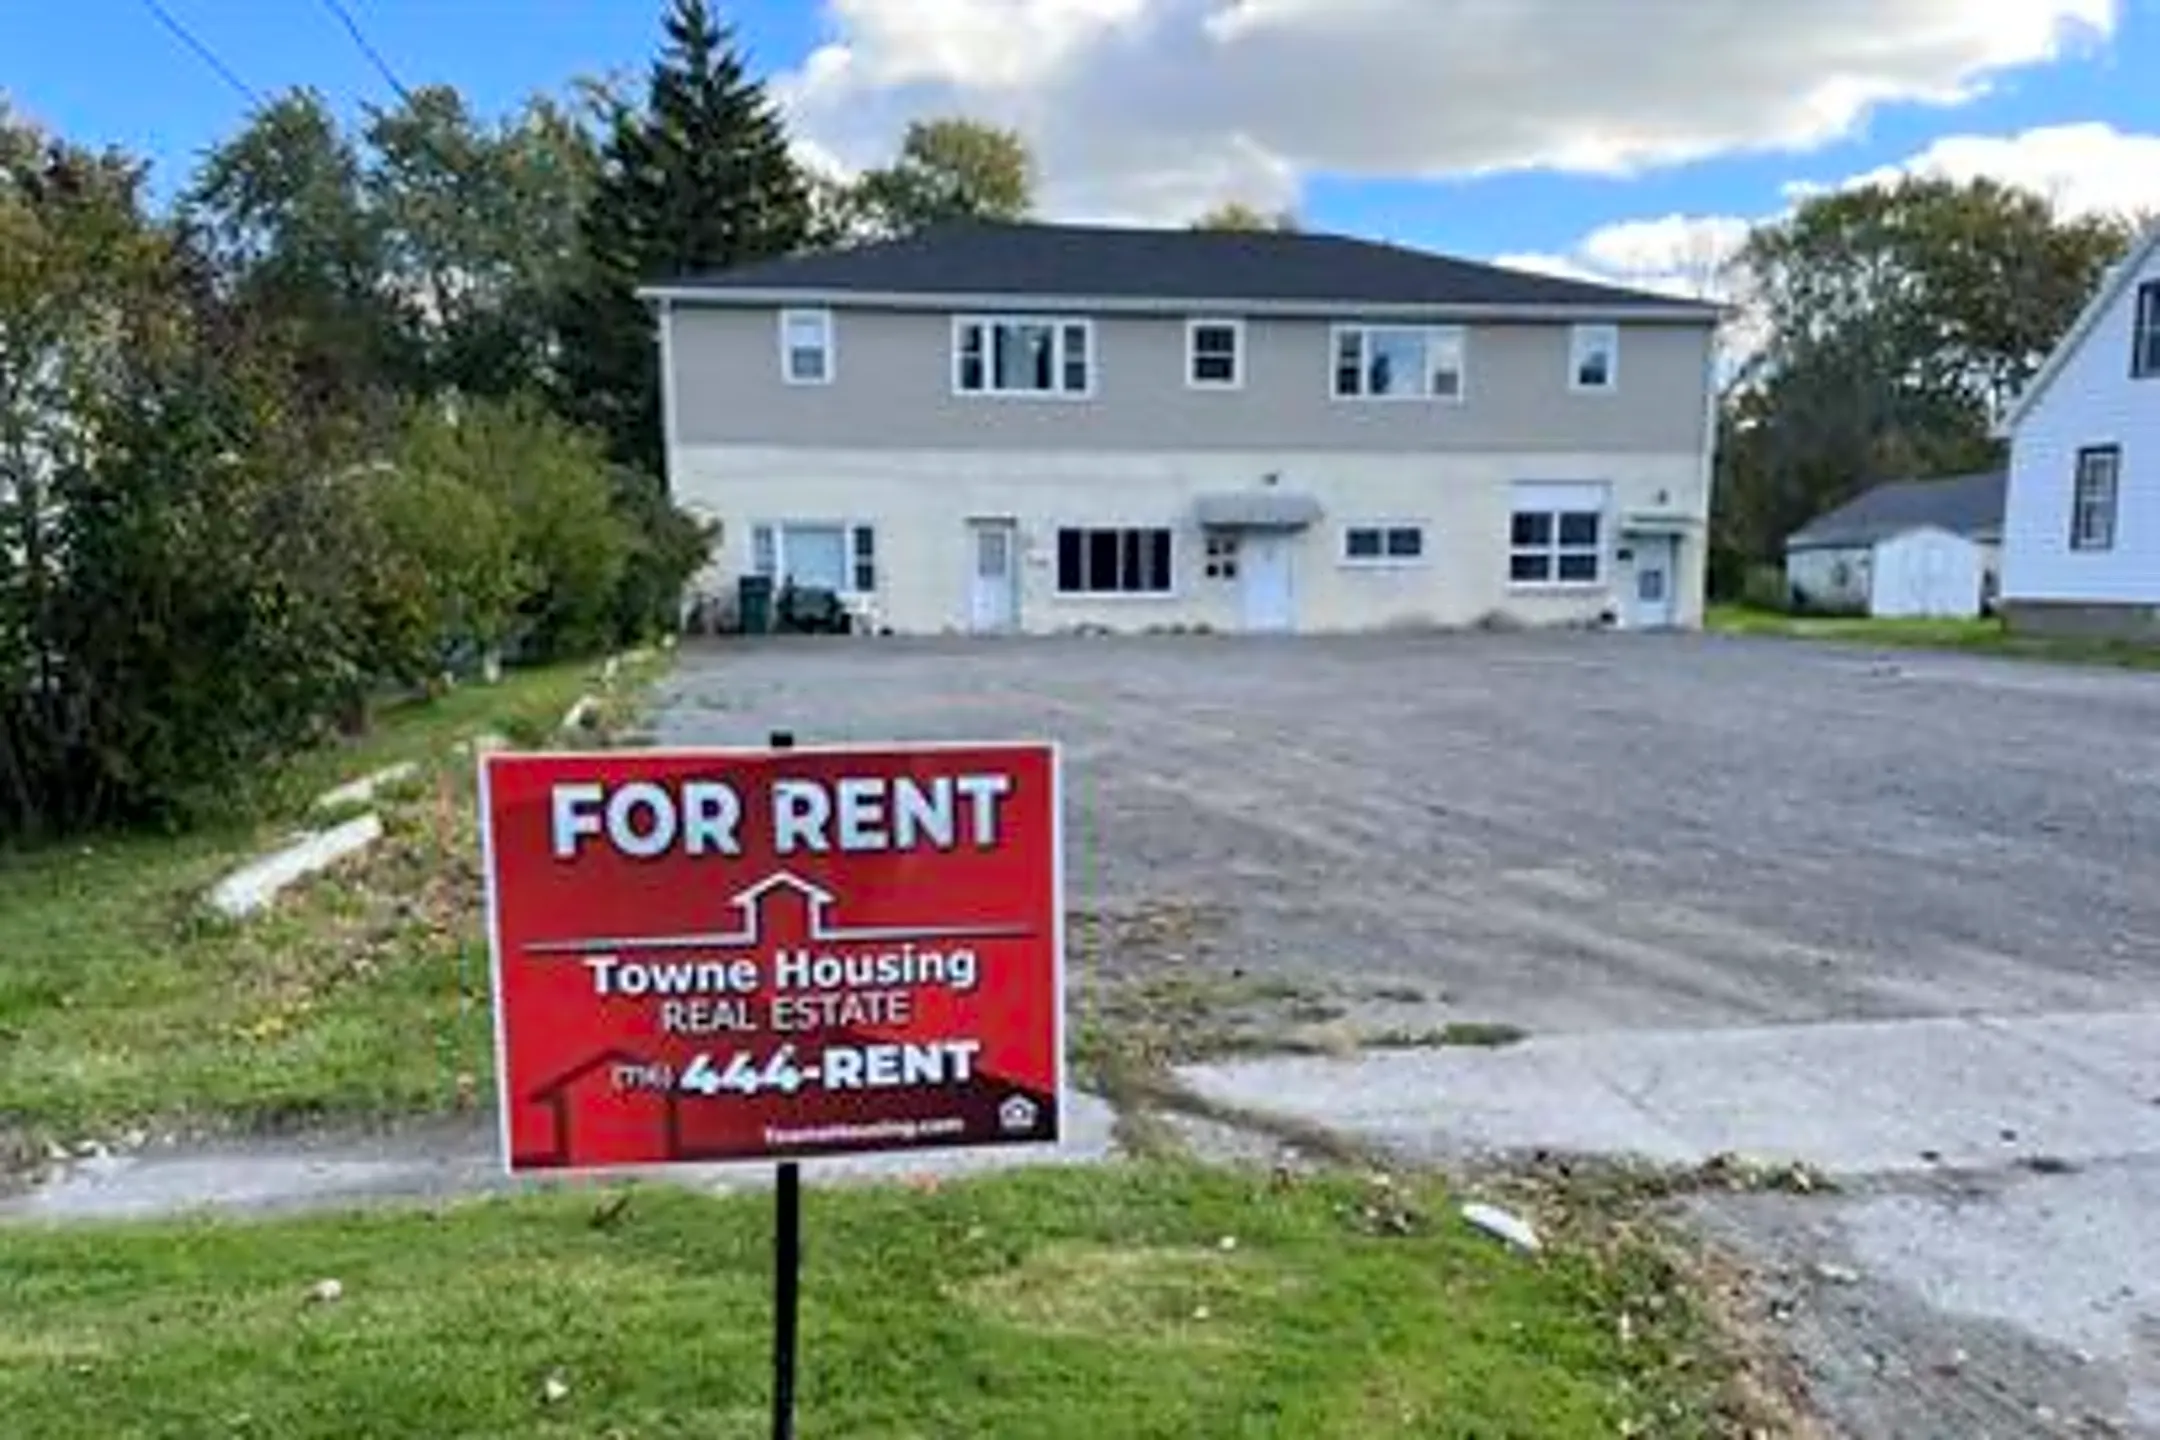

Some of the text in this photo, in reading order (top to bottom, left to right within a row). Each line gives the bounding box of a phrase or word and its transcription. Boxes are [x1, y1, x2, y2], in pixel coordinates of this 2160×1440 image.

[551, 776, 1010, 857] FOR RENT
[583, 945, 977, 994] Towne Housing
[661, 991, 910, 1032] REAL ESTATE
[680, 1040, 981, 1095] 444-RENT
